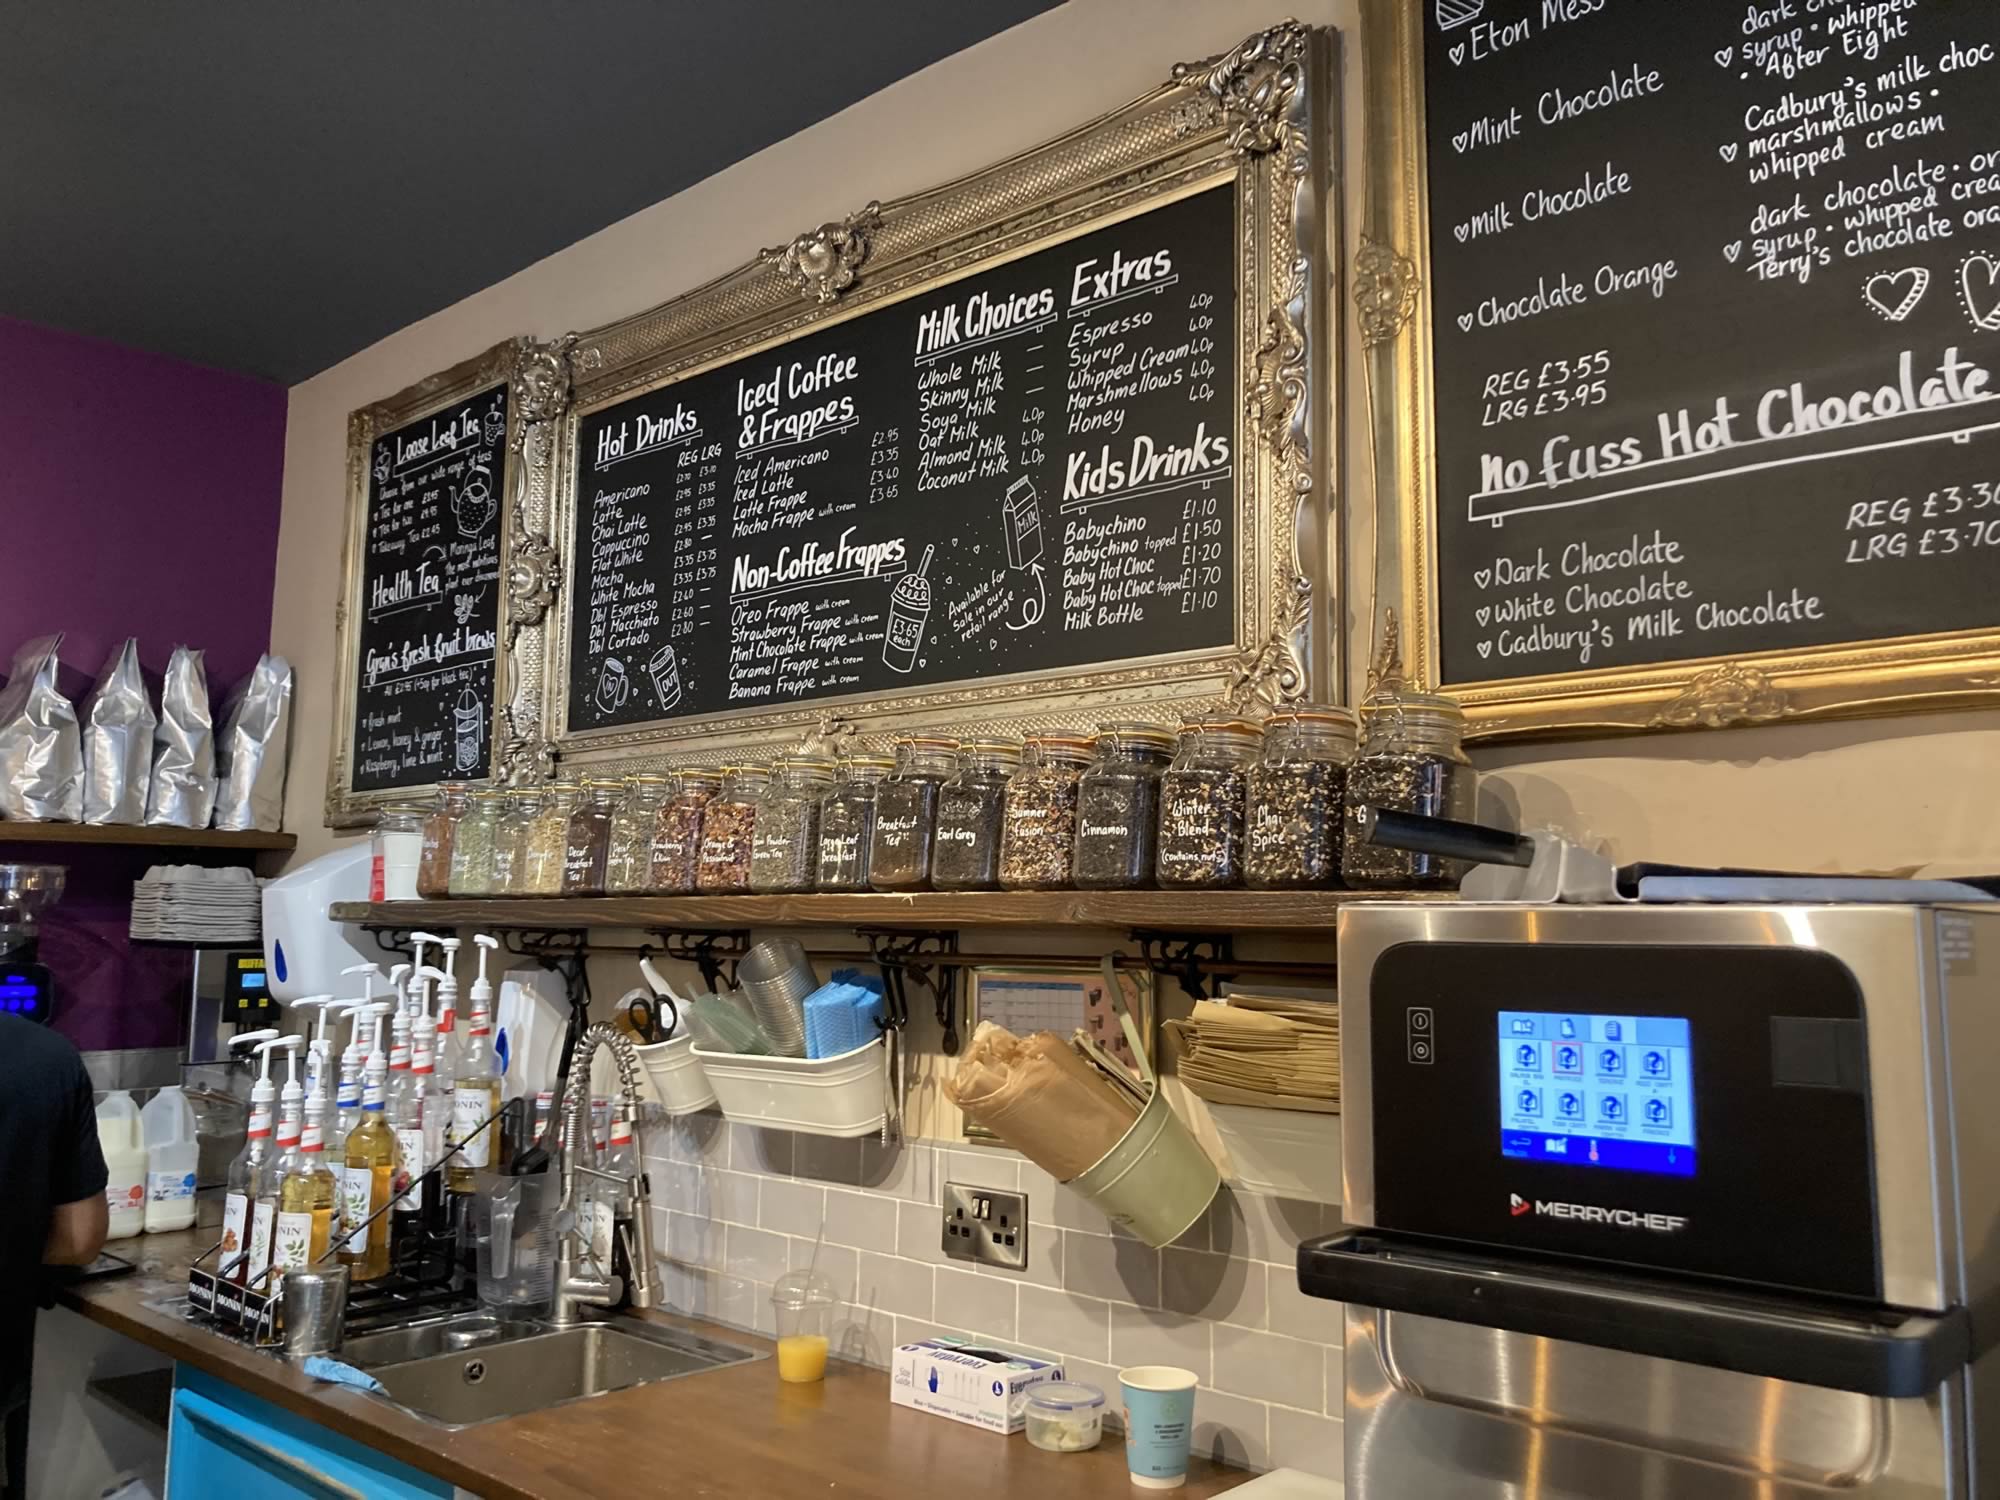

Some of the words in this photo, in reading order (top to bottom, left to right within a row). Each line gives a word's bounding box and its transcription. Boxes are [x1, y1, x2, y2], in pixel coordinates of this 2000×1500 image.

[1742, 0, 1797, 35] dark
[1470, 18, 1530, 60] Eton
[1742, 27, 1802, 66] syrup
[1765, 46, 1830, 80] After
[1842, 15, 1909, 60] Eight
[1745, 76, 1867, 132] Cadbury's
[1877, 55, 1931, 92] milk
[1939, 41, 1995, 73] choc
[1470, 107, 1522, 149] Mint
[1538, 63, 1664, 124] Chocolate
[1748, 91, 1923, 158] marshmallows
[1749, 136, 1846, 184] whipped
[1866, 114, 1945, 150] cream
[1471, 201, 1514, 239] Milk
[1522, 161, 1632, 221] Chocolate
[1750, 193, 1811, 234] dark
[1824, 159, 1946, 211] chocolate
[1752, 227, 1817, 265] syrup
[1844, 186, 1938, 230] whipped
[1747, 246, 1831, 284] Terry's
[1844, 212, 1953, 257] chocolate
[1070, 249, 1172, 306] Extras
[1478, 273, 1587, 327] Chocolate
[1595, 260, 1678, 298] Orange
[916, 304, 961, 354] Milk
[965, 288, 1055, 338] Choices
[1067, 312, 1153, 348] Espresso
[917, 363, 962, 390] Whole
[971, 351, 1002, 375] Milk
[1067, 352, 1137, 391] Whipped
[1139, 344, 1189, 372] Cream
[1069, 342, 1125, 372] Syrup
[1482, 369, 1530, 399] REG
[1537, 350, 1610, 388] £3.55
[737, 366, 781, 416] Iced
[788, 353, 859, 399] Coffee
[919, 387, 970, 412] Skinny
[974, 371, 1004, 398] Milk
[919, 413, 958, 435] Soya
[965, 396, 997, 419] Milk
[1482, 398, 1528, 426] LRG
[1534, 380, 1607, 415] £3.95
[1538, 434, 1643, 489] fuss
[1657, 396, 1739, 460] Hot
[1756, 346, 1993, 441] Chocolate
[397, 437, 429, 465] Loose
[432, 420, 457, 450] Leaf
[459, 408, 480, 438] Tea
[598, 422, 628, 463] Hot
[636, 403, 697, 450] Drinks
[919, 431, 944, 451] Oat
[949, 421, 979, 444] Milk
[1067, 408, 1125, 435] Honey
[677, 450, 698, 468] REG
[701, 443, 722, 460] LRG
[734, 460, 761, 485] Iced
[763, 449, 829, 477] Americano
[918, 442, 973, 472] Almond
[977, 435, 1006, 459] Milk
[1063, 444, 1126, 501] Kids
[1128, 422, 1230, 487] Drinks
[733, 480, 758, 502] Iced
[761, 472, 794, 495] Latte
[917, 461, 977, 492] Coconut
[979, 454, 1009, 477] Milk
[594, 484, 650, 508] Americano
[733, 500, 764, 520] Latte
[767, 490, 808, 513] Frappe
[592, 524, 614, 542] Chai
[618, 513, 647, 535] Latte
[593, 505, 624, 526] Latte
[732, 518, 768, 539] Mocha
[771, 507, 815, 530] Frappe
[1017, 511, 1038, 534] Milk
[1064, 514, 1147, 547] Babychino
[1846, 497, 1911, 531] REG
[591, 558, 612, 573] Flat
[615, 550, 644, 568] White
[592, 533, 649, 558] Cappuccino
[731, 541, 835, 593] Non-Coffee
[836, 526, 906, 577] Frappes
[1062, 539, 1139, 567] Babychino
[1145, 527, 1178, 554] topped
[1494, 549, 1551, 587] Dark
[1560, 529, 1685, 580] Chocolate
[1846, 532, 1908, 564] LRG
[373, 569, 413, 607] Health
[416, 561, 439, 594] Tea
[590, 588, 618, 606] White
[623, 579, 655, 599] Mocha
[591, 570, 624, 589] Mocha
[1063, 566, 1096, 593] Baby
[1099, 559, 1122, 581] Hot
[1124, 557, 1155, 577] Choc
[1063, 588, 1096, 611] Baby
[1100, 581, 1123, 602] Hot
[1124, 579, 1155, 598] Choc
[1157, 574, 1183, 597] topped
[590, 606, 607, 624] Dbl
[611, 600, 658, 619] Espresso
[732, 605, 762, 626] Oreo
[765, 599, 810, 619] Frappe
[1494, 586, 1556, 625] White
[1565, 571, 1694, 617] Chocolate
[589, 622, 606, 639] Dbl
[610, 611, 660, 633] Macchiato
[731, 623, 796, 644] Strawberry
[801, 615, 842, 633] Frappe
[1064, 610, 1092, 631] Milk
[1097, 602, 1144, 626] Bottle
[1497, 619, 1614, 664] Cadbury's
[1628, 613, 1683, 642] Milk
[1696, 588, 1825, 633] Chocolate
[401, 634, 430, 672] fresh
[434, 627, 461, 662] fruit
[465, 626, 496, 650] brews
[589, 638, 605, 654] Dbl
[608, 629, 650, 650] Cortado
[730, 643, 752, 663] Mint
[756, 636, 806, 659] Chocolate
[810, 633, 847, 652] Frappe
[729, 658, 778, 681] Caramel
[779, 657, 820, 676] Frappe
[729, 682, 771, 699] Banana
[776, 676, 816, 696] Frappe
[877, 815, 918, 832] Breakfast
[1010, 804, 1047, 819] Summer
[1172, 798, 1211, 816] Winter
[1257, 805, 1283, 827] Chai
[884, 833, 901, 846] Tea
[937, 828, 953, 840] Earl
[955, 828, 977, 847] Grey
[1081, 819, 1128, 838] Cinnamon
[1177, 819, 1210, 837] Blend
[1252, 831, 1285, 851] Spice
[1535, 1200, 1688, 1230] MERRYCHEF
